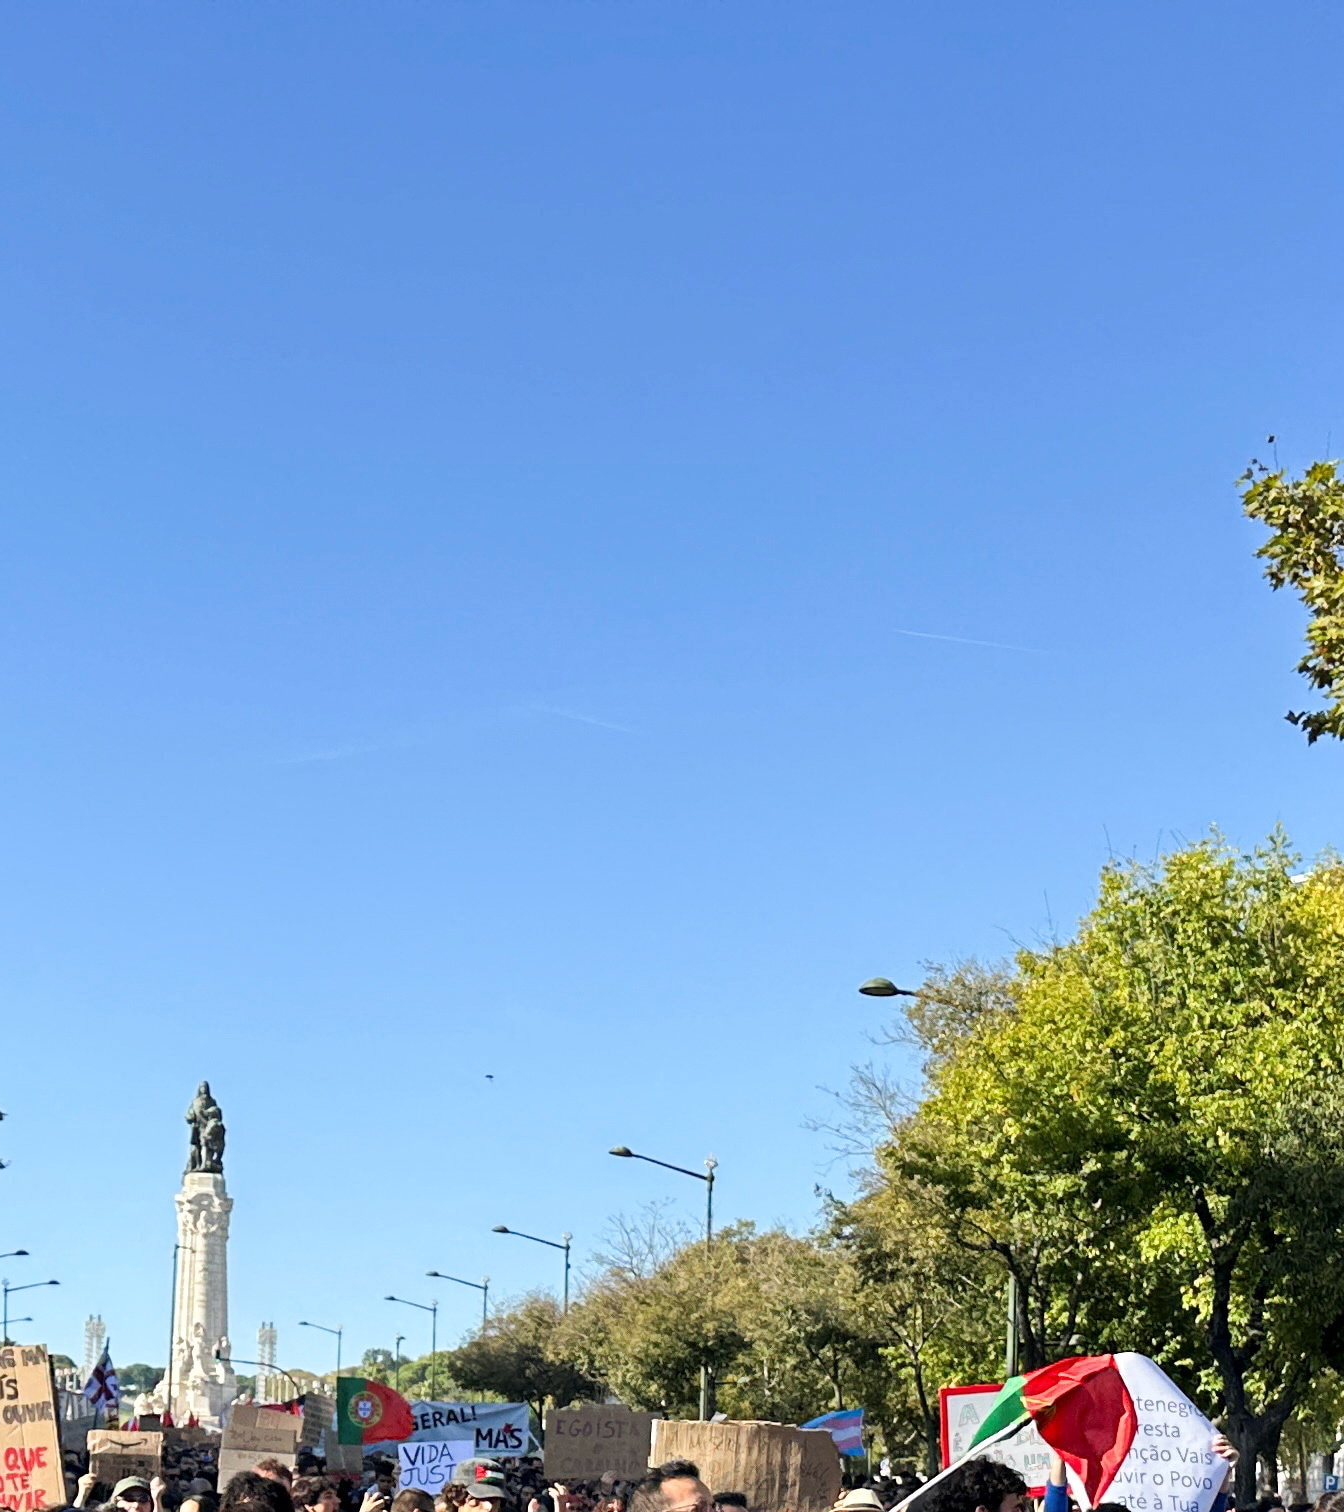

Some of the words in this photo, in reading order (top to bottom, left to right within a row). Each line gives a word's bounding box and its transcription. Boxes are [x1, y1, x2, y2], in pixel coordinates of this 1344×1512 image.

[1135, 1395, 1206, 1418] tenegro
[1137, 1422, 1181, 1439] resta
[3, 1446, 49, 1473] QUE
[402, 1443, 454, 1467] VIDA
[1128, 1445, 1172, 1464] nção
[1175, 1447, 1213, 1465] Vais
[6, 1473, 31, 1493] TE
[400, 1463, 458, 1487] JUST
[1113, 1471, 1146, 1484] uvir
[1152, 1473, 1164, 1486] o
[1170, 1470, 1213, 1491] Povo
[1325, 1476, 1336, 1490] P
[1117, 1494, 1148, 1510] até
[1153, 1493, 1163, 1511] à
